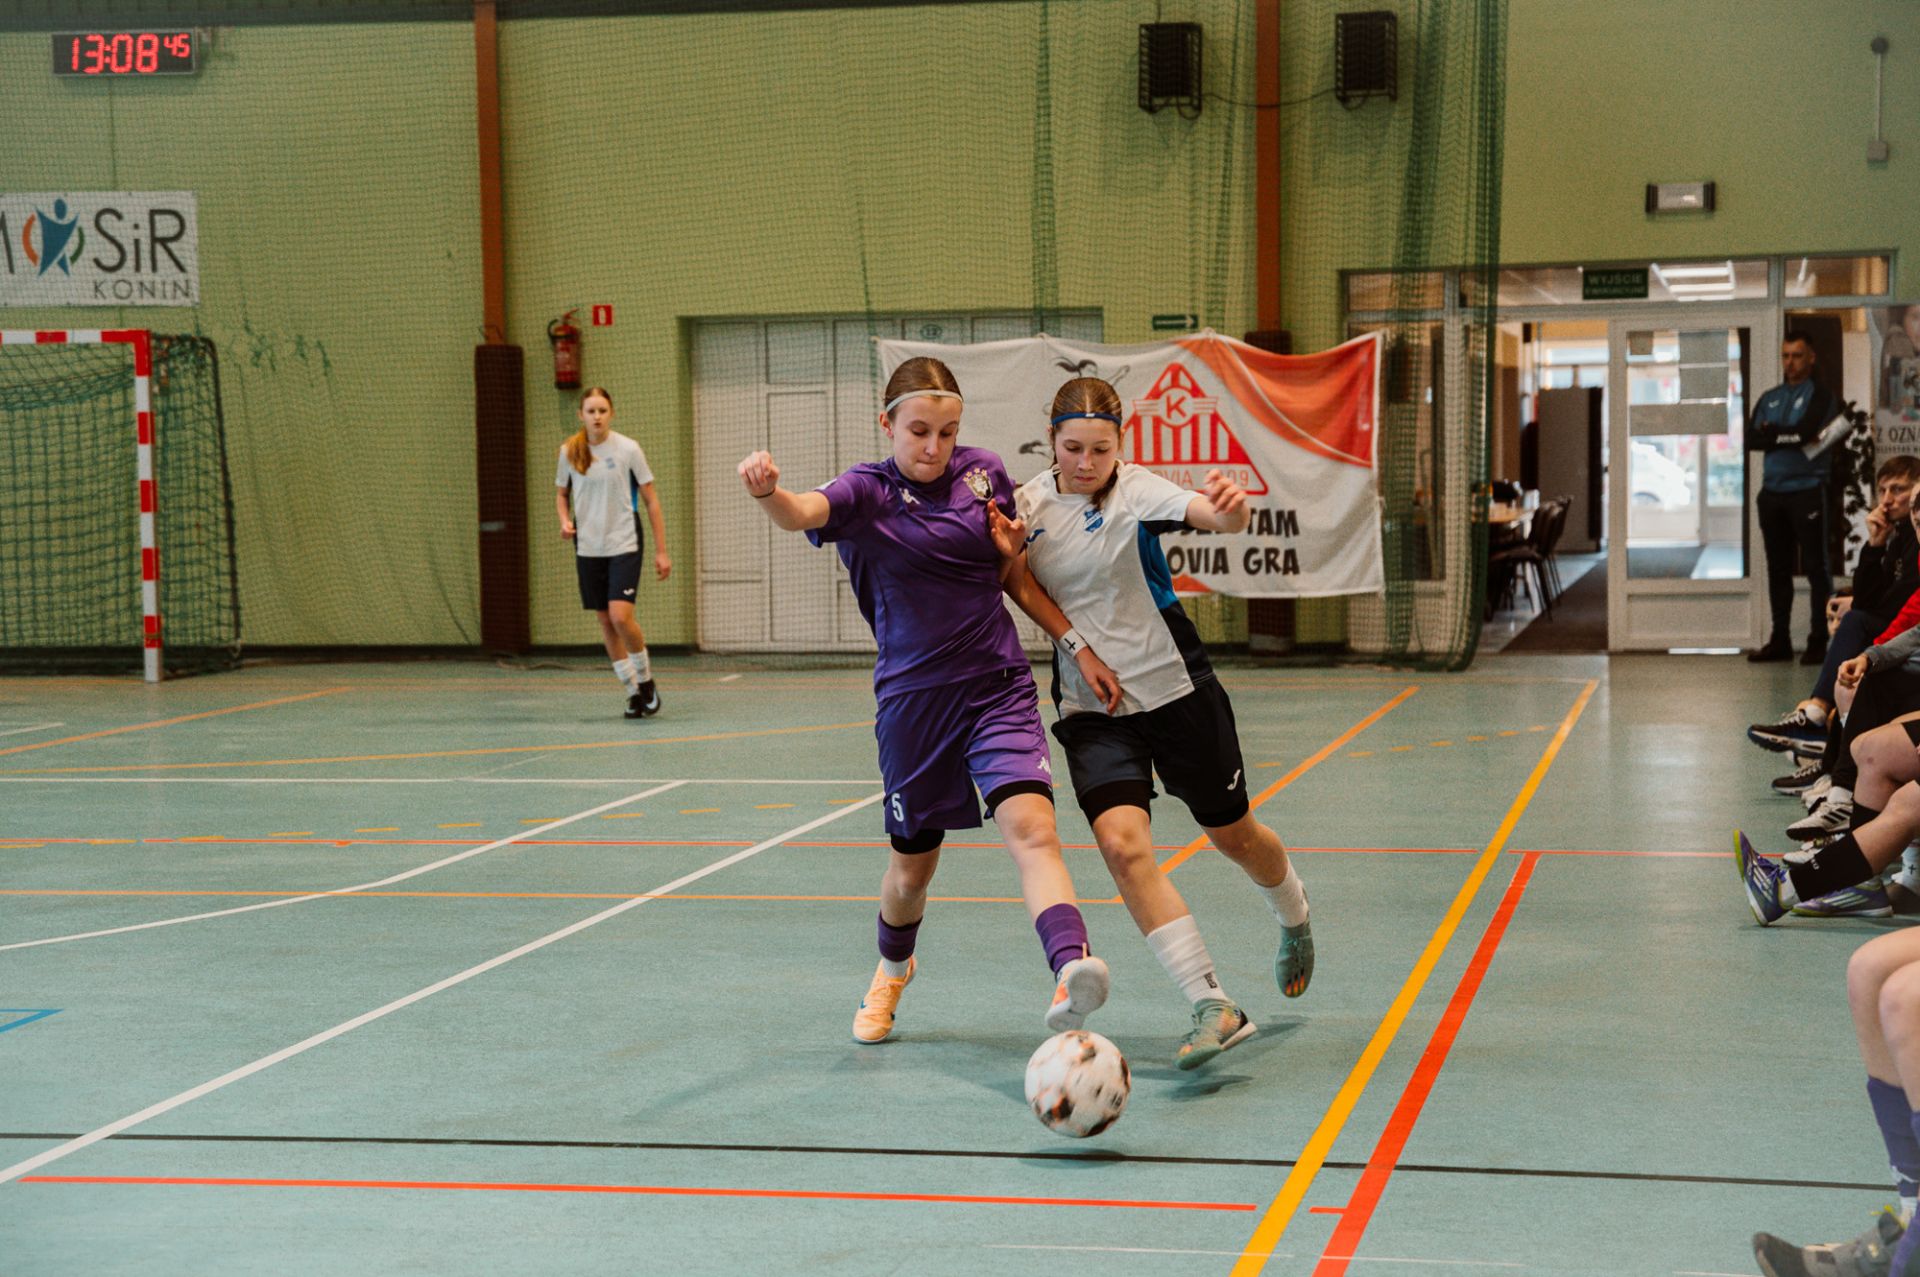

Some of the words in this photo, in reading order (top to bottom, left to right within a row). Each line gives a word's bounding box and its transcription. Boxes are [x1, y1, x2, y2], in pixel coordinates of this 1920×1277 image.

[72, 33, 159, 74] 13:08
[163, 34, 190, 57] 45
[93, 279, 191, 300] KONIN
[1166, 394, 1188, 420] K
[1166, 545, 1230, 575] OVIA
[1243, 547, 1300, 576] GRA
[891, 793, 905, 822] 5
